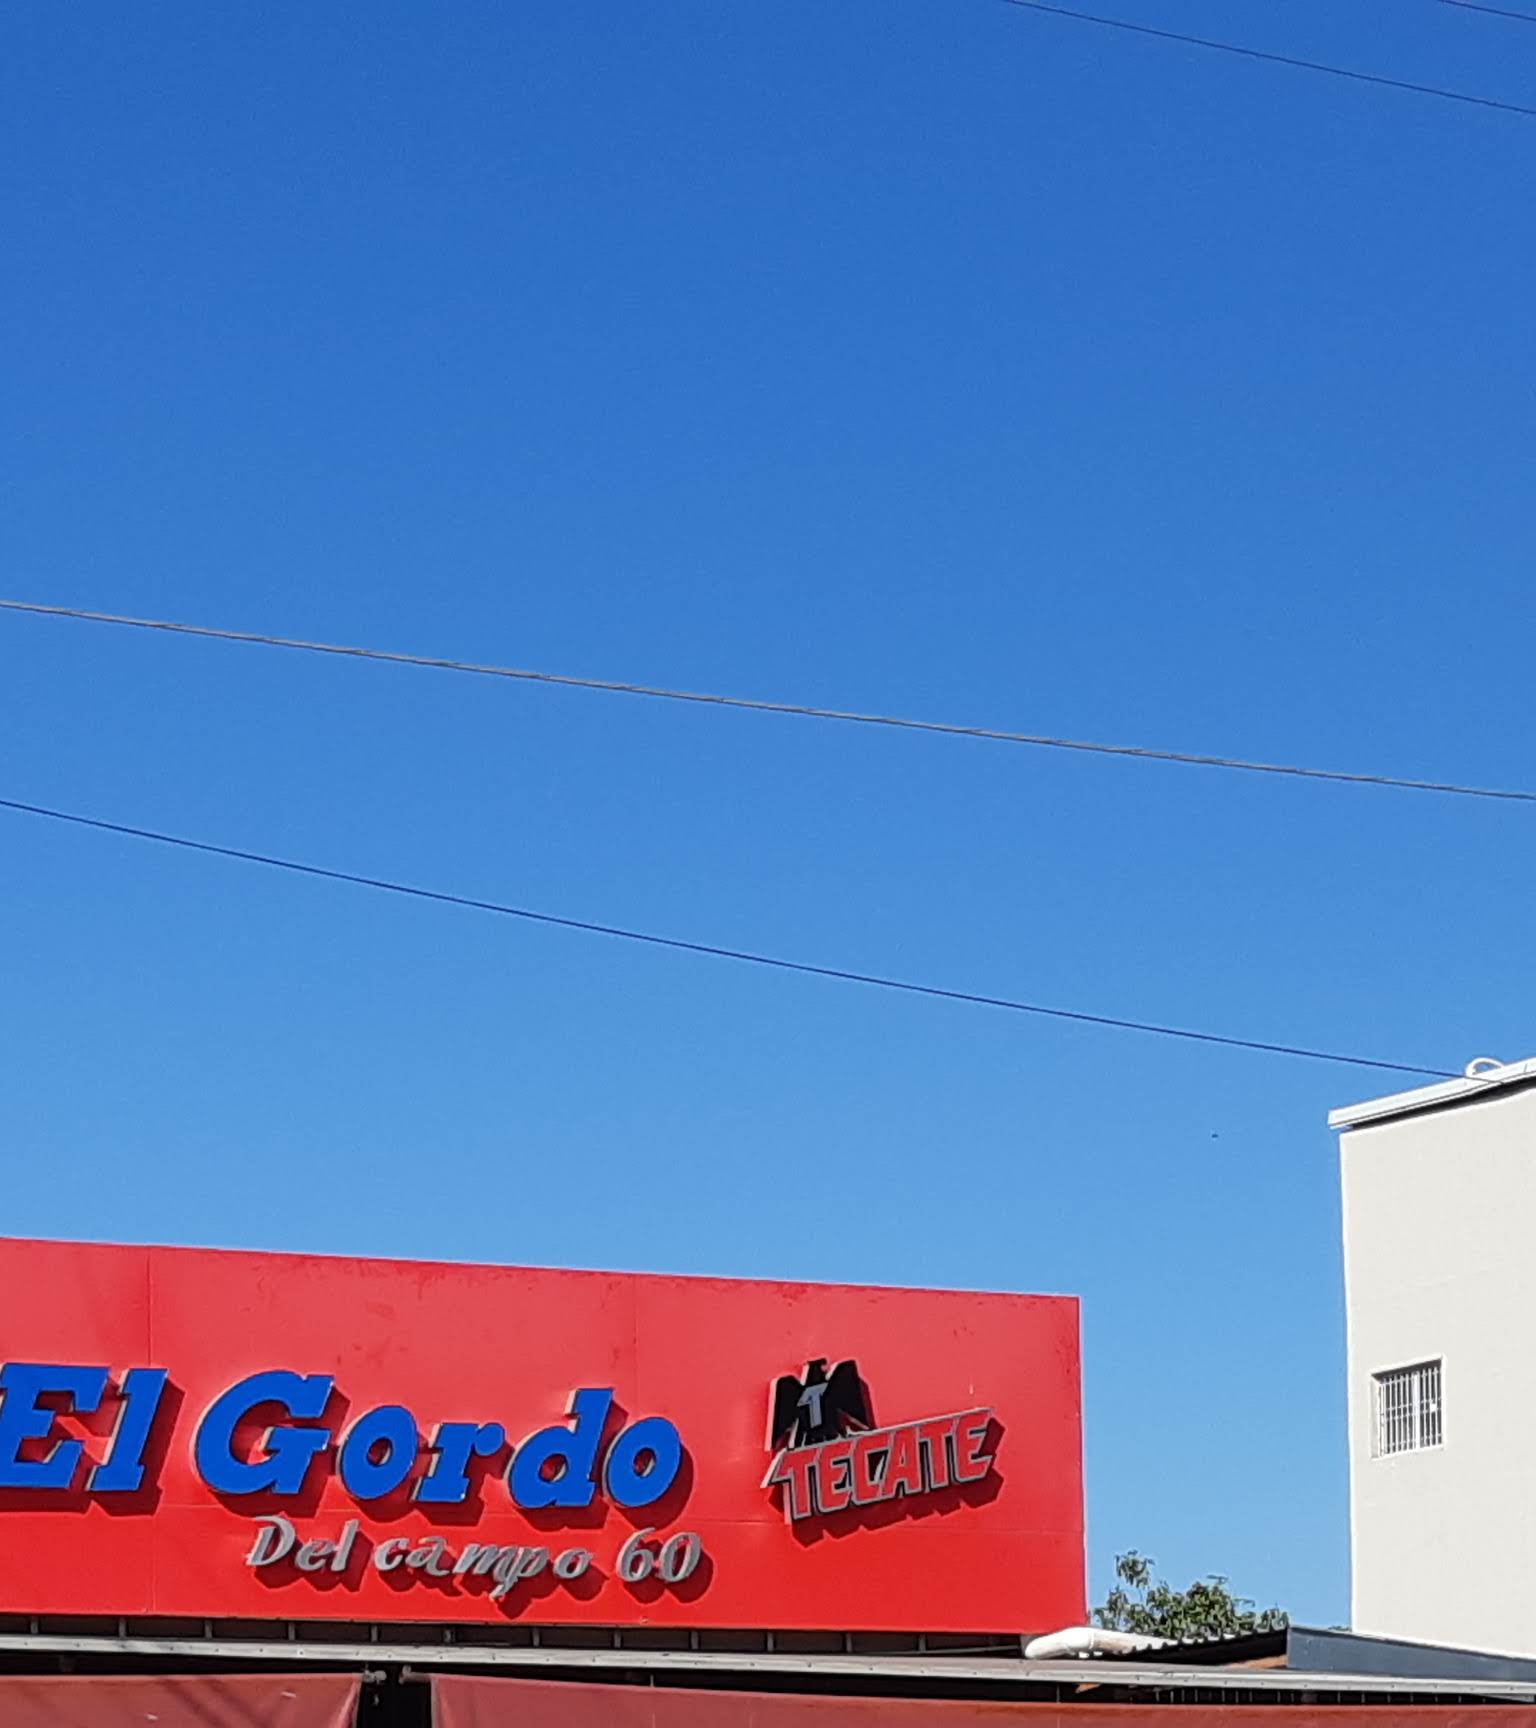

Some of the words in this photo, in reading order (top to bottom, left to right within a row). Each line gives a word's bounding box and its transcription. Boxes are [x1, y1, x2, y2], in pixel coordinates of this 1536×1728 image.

[193, 1368, 682, 1509] Gordo
[761, 1406, 993, 1523] TECATE
[245, 1515, 359, 1573] Del
[373, 1534, 595, 1602] campo
[616, 1527, 701, 1584] 60
